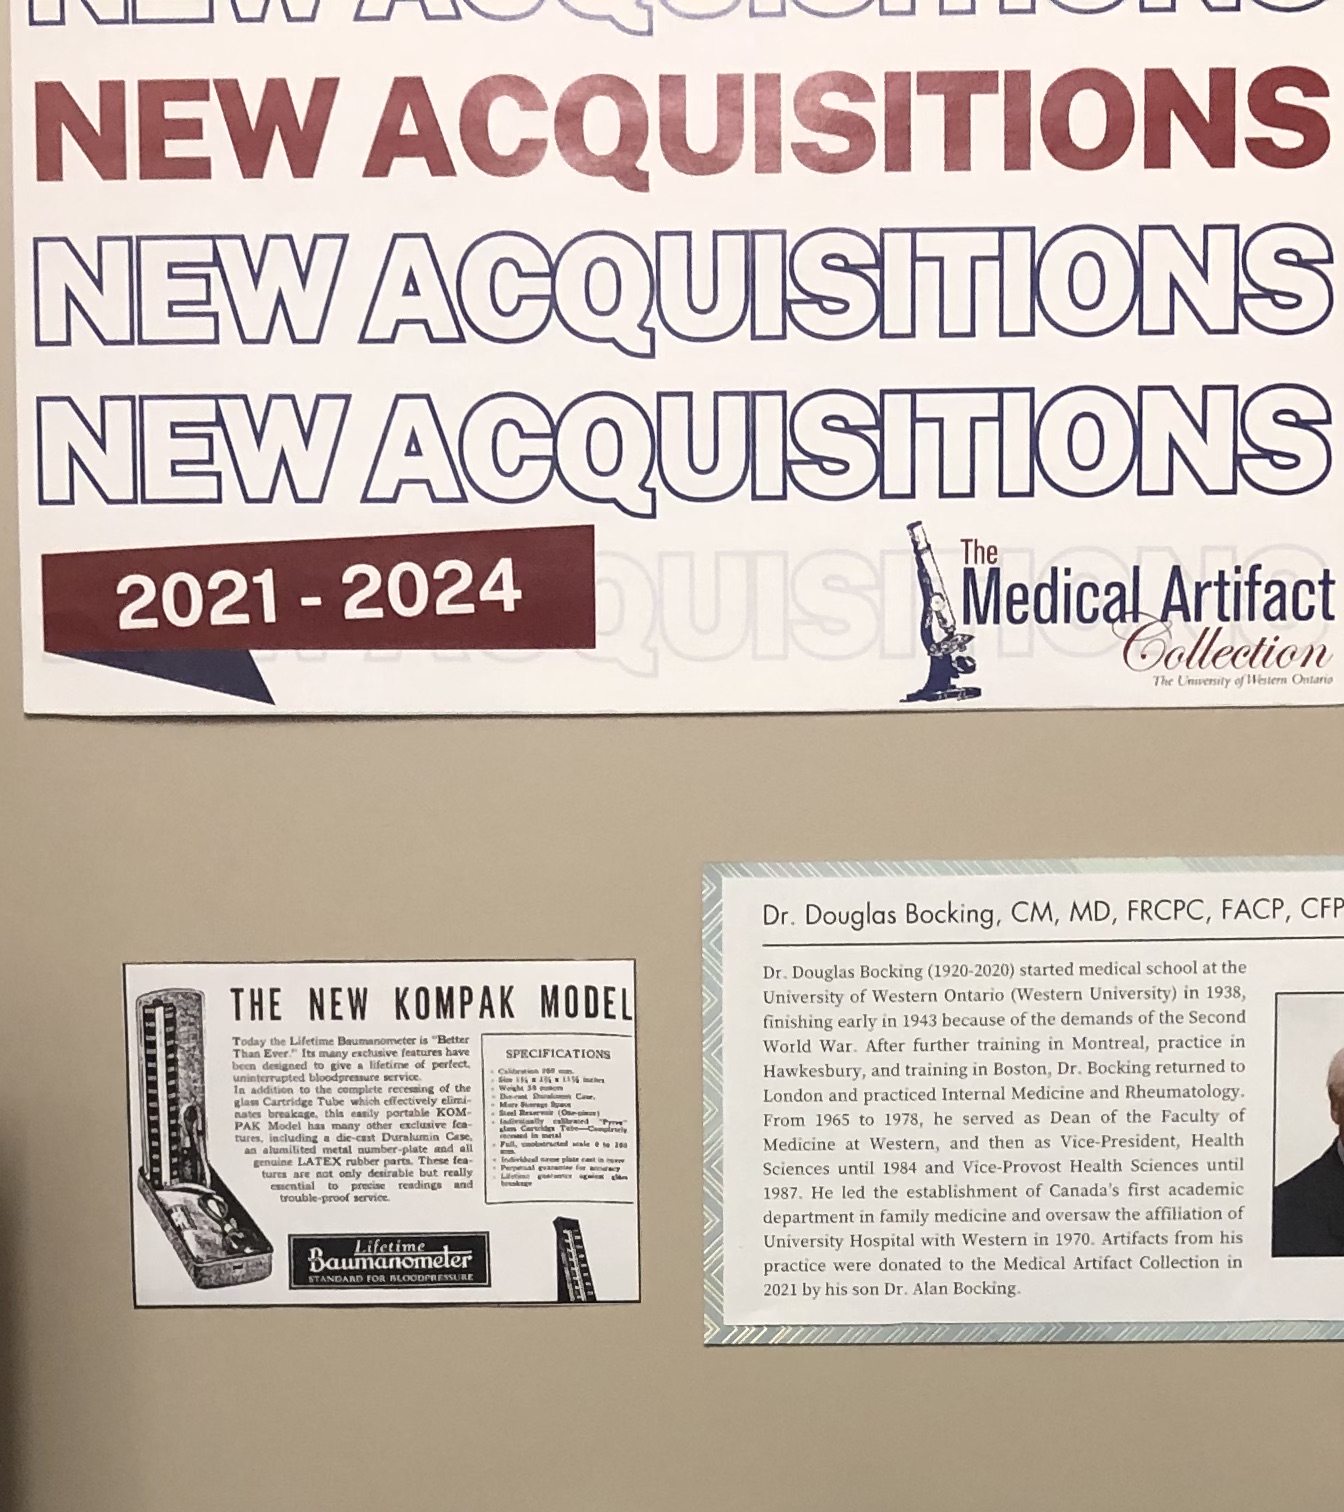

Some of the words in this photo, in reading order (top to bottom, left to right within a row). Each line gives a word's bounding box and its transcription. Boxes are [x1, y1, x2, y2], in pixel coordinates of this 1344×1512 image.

[35, 77, 340, 181] NEW
[362, 66, 1330, 192] ACQUISITIONS
[33, 233, 349, 347] NEW
[357, 222, 1334, 359] ACQUISITIONS
[36, 394, 351, 506] NEW
[360, 383, 1332, 519] ACQUISITIONS
[961, 539, 997, 564] The
[117, 569, 276, 629] 2021
[342, 558, 522, 619] 2024
[964, 566, 1141, 624] Medical
[1159, 564, 1335, 622] Artifact
[1112, 611, 1333, 671] Collection
[1153, 674, 1173, 685] The
[1177, 674, 1230, 687] University
[1234, 673, 1246, 688] of
[1246, 673, 1287, 685] Western
[1291, 674, 1333, 685] Ontario
[764, 904, 794, 925] Dr.
[806, 901, 896, 931] Douglas
[907, 901, 1001, 929] Bocking,
[1012, 901, 1059, 926] CM,
[1070, 901, 1117, 925] MD,
[1129, 899, 1211, 924] FRCPC,
[1223, 898, 1290, 923] FACP,
[763, 966, 786, 979] Dr.
[793, 965, 854, 982] Douglas
[860, 964, 923, 981] Bocking
[928, 964, 1014, 980] (1920-2020)
[1020, 962, 1073, 976] started
[1079, 961, 1141, 975] medical
[1147, 960, 1197, 975] school
[1203, 962, 1217, 974] at
[1222, 960, 1246, 973] the
[230, 988, 281, 1021] THE
[310, 987, 367, 1021] NEW
[396, 985, 514, 1020] KOMPAK
[541, 985, 632, 1020] MODEL
[764, 990, 843, 1007] University
[850, 989, 867, 1003] of
[872, 990, 937, 1002] Western
[945, 988, 1004, 1002] Ontario
[1011, 988, 1082, 1004] (Western
[1091, 986, 1176, 1003] University)
[1184, 985, 1199, 999] in
[1207, 986, 1245, 1001] 1938,
[232, 1037, 266, 1048] Today
[270, 1037, 285, 1045] the
[290, 1036, 334, 1045] Lifetime
[338, 1036, 416, 1046] Baumanometer
[420, 1036, 428, 1045] is
[506, 1049, 610, 1059] SPECIFICATIONS
[309, 1246, 473, 1272] Baumanometer
[354, 1239, 426, 1254] Lifetime
[309, 1274, 362, 1283] STANDARD
[366, 1274, 385, 1283] FOR
[389, 1273, 473, 1282] BLOODPRESSURE
